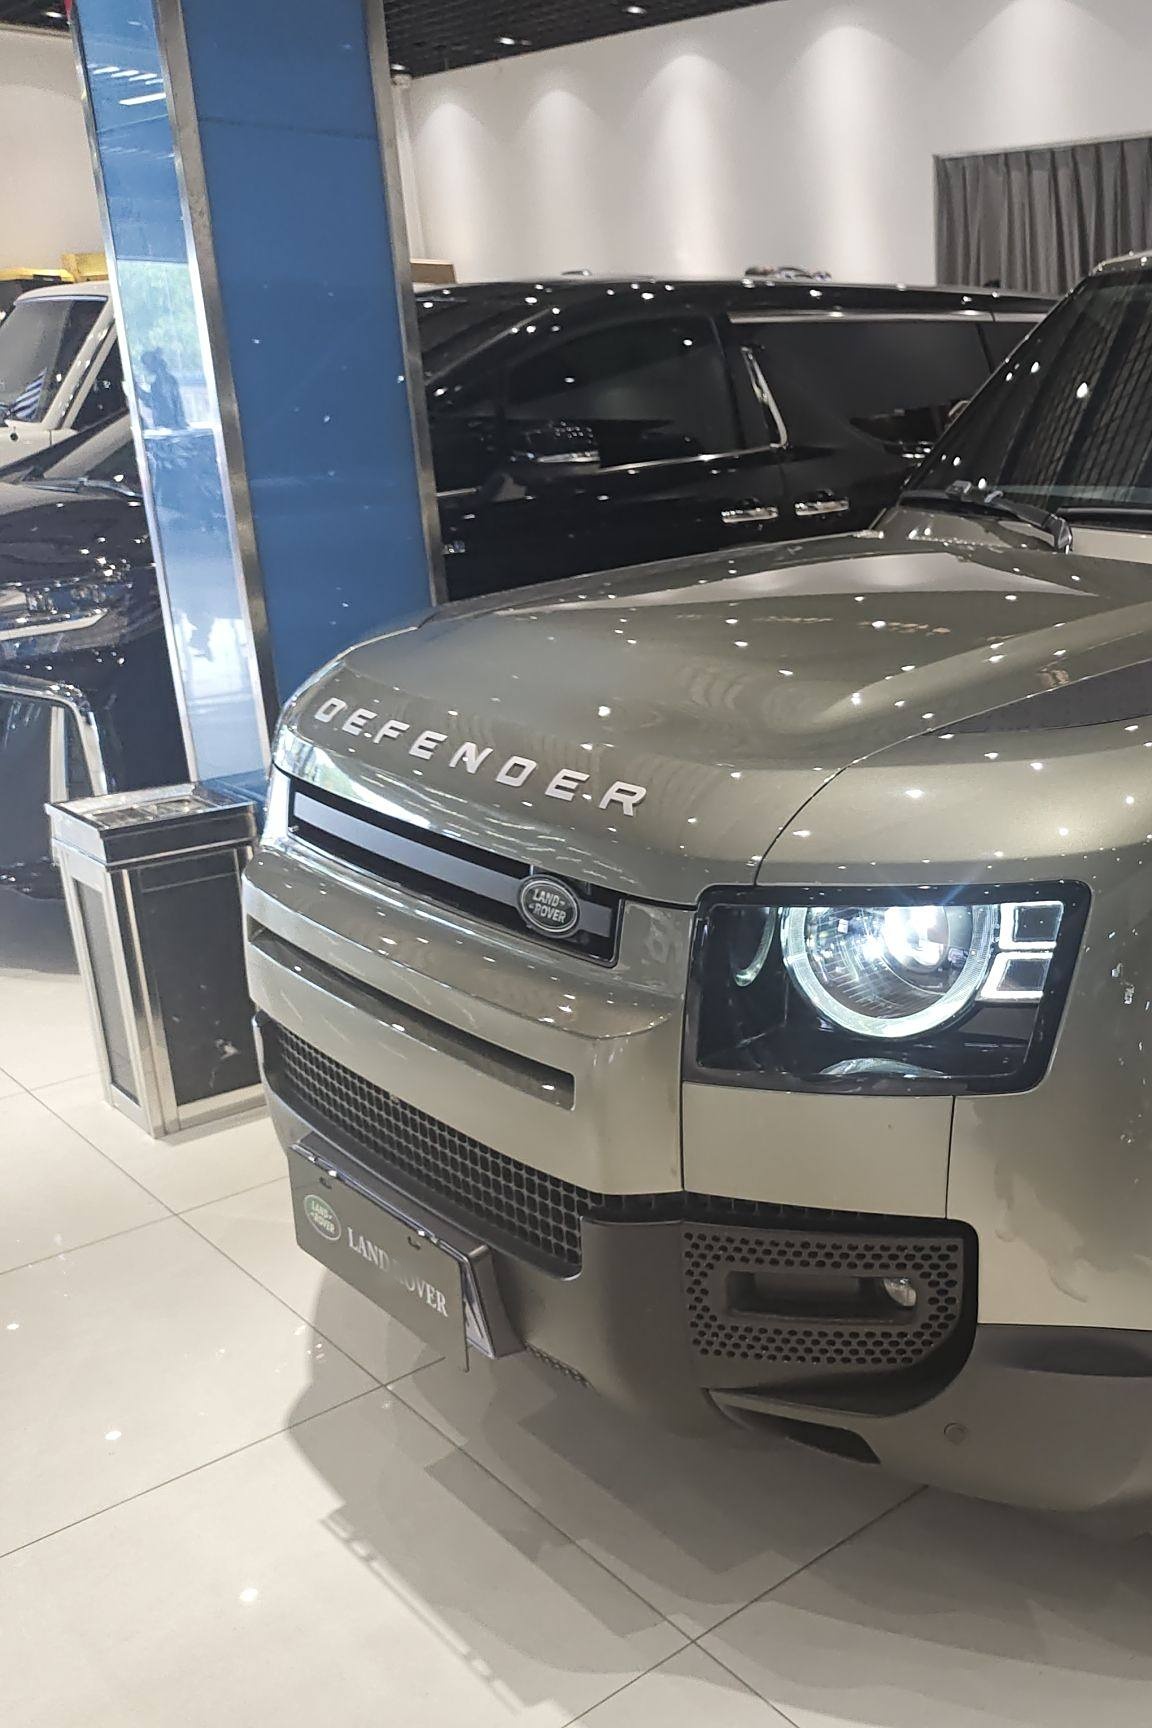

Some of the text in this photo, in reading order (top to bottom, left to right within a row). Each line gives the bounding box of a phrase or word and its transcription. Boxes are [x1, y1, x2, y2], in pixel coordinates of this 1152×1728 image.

[314, 697, 647, 816] DEFENDER
[347, 1226, 448, 1317] LAND OVER
